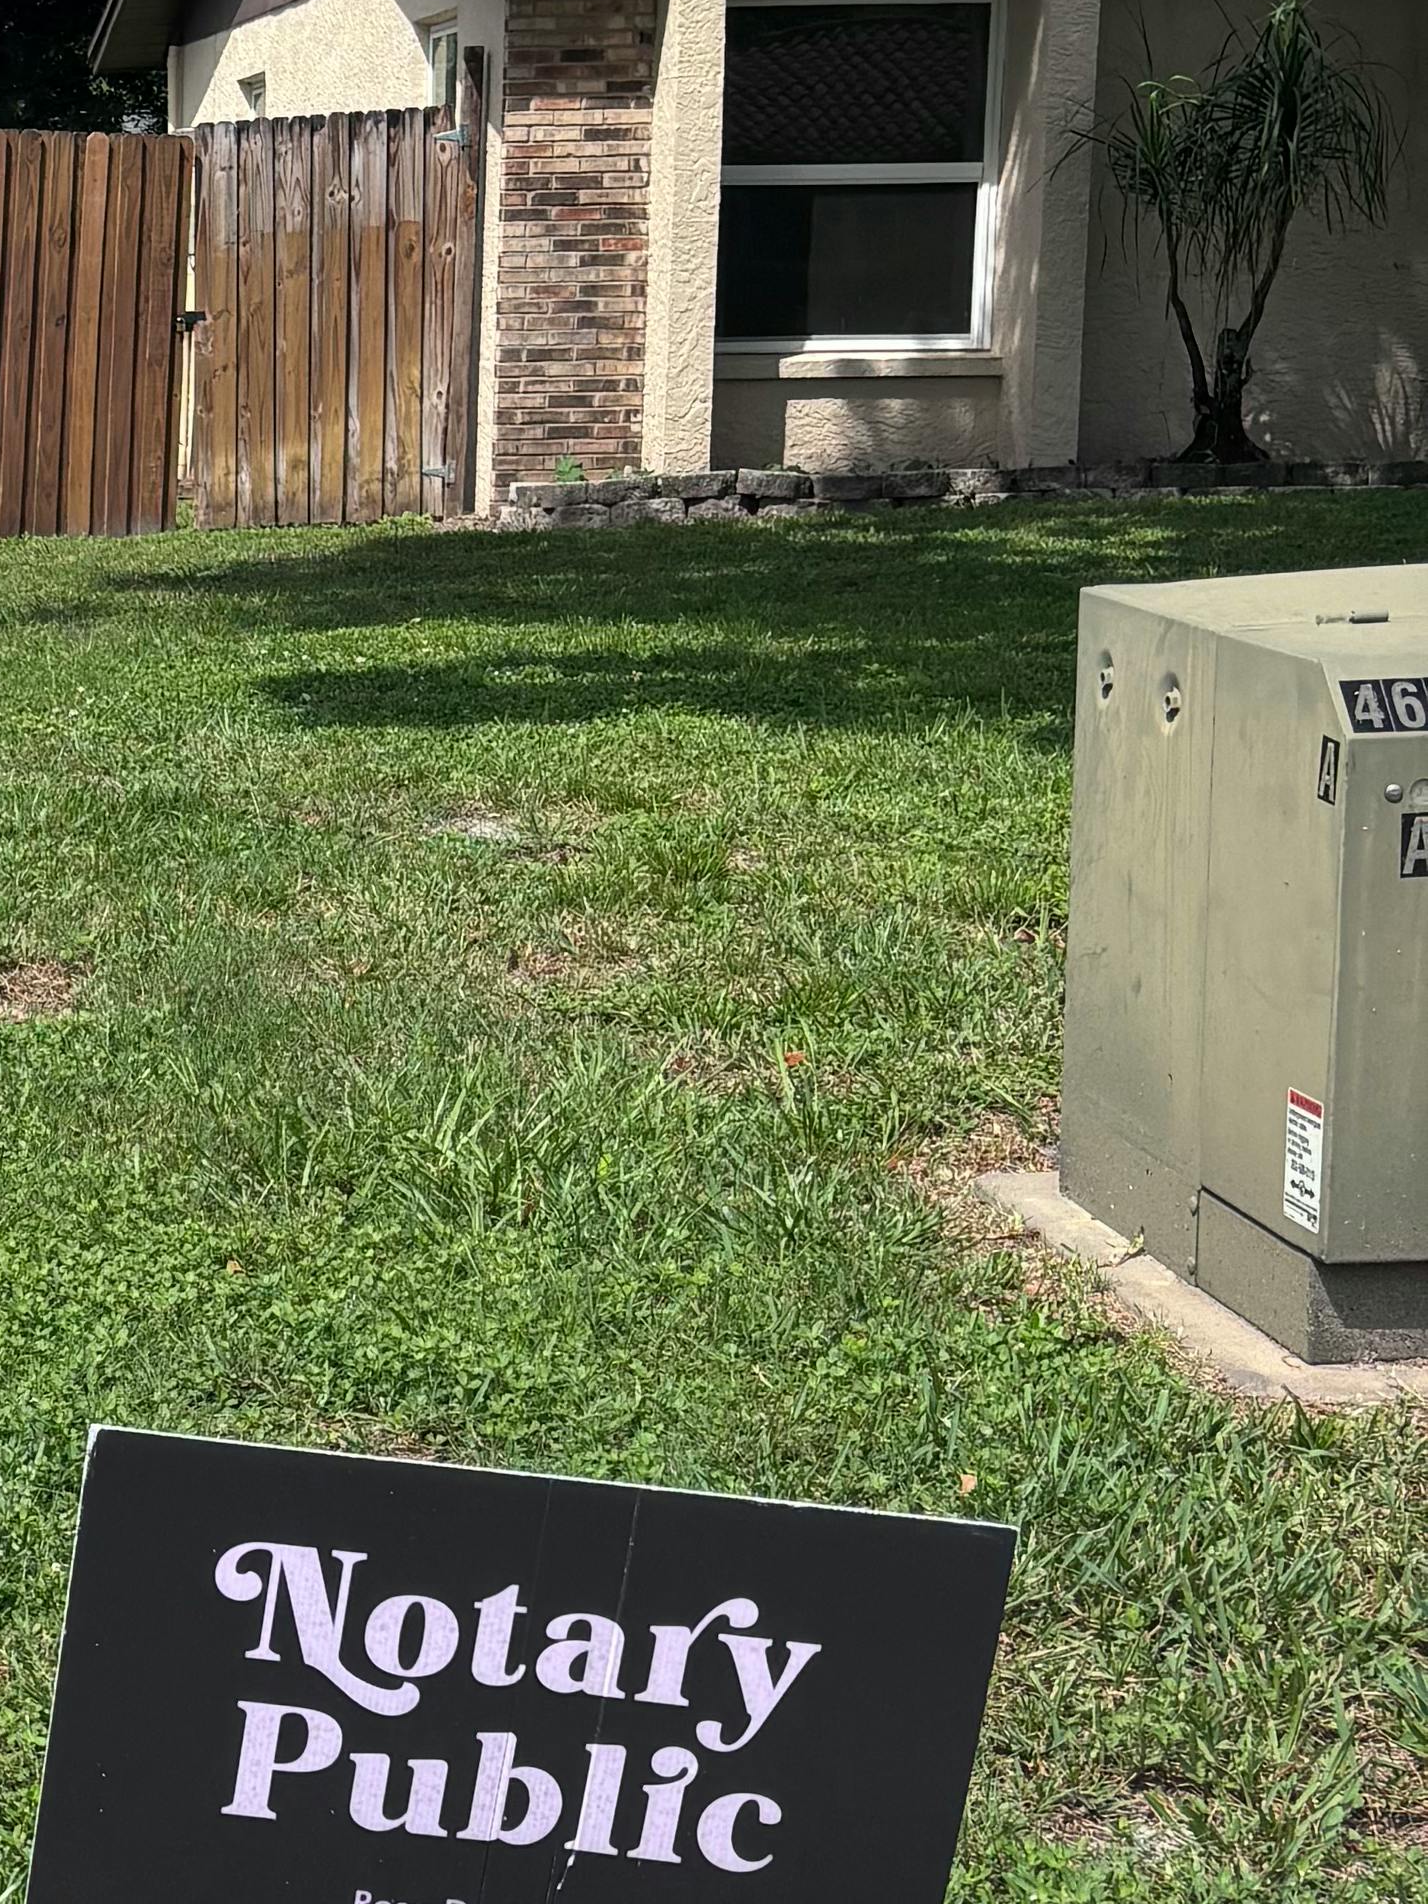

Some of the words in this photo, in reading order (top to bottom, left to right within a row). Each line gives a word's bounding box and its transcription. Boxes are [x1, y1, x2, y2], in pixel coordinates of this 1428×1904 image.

[1319, 742, 1335, 805] A
[214, 1540, 822, 1754] Notary
[220, 1700, 783, 1874] Public
